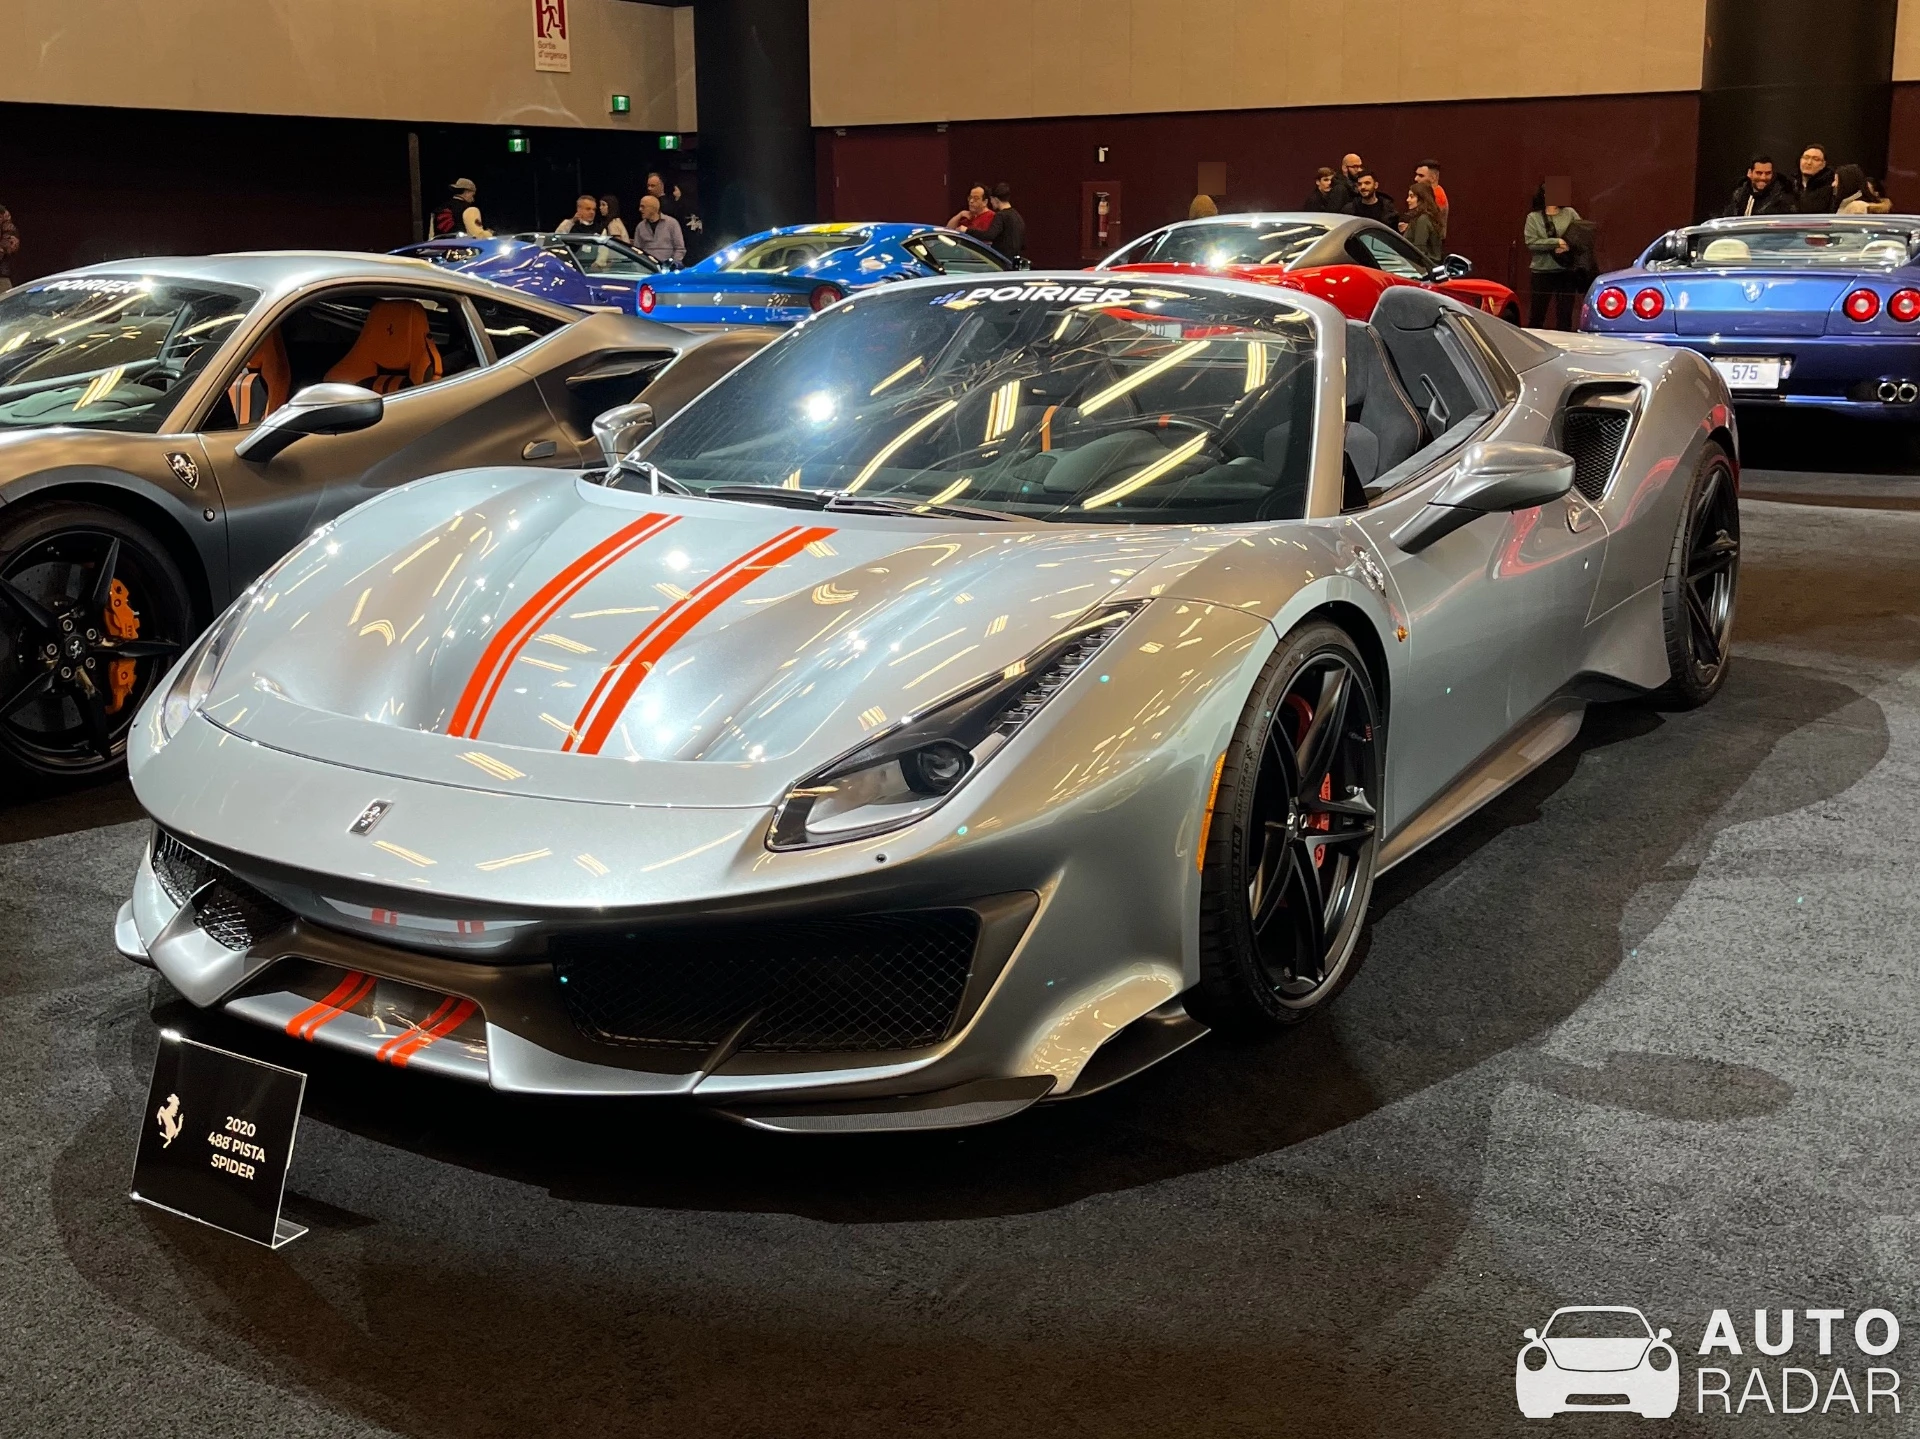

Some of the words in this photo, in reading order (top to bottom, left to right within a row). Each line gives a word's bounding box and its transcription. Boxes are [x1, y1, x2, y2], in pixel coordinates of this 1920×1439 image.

[965, 286, 1131, 303] POIRIER
[1731, 365, 1759, 380] 575
[225, 1116, 256, 1137] 2020
[207, 1131, 230, 1150] 488
[232, 1139, 265, 1163] PISTA
[211, 1153, 255, 1180] SPIDER
